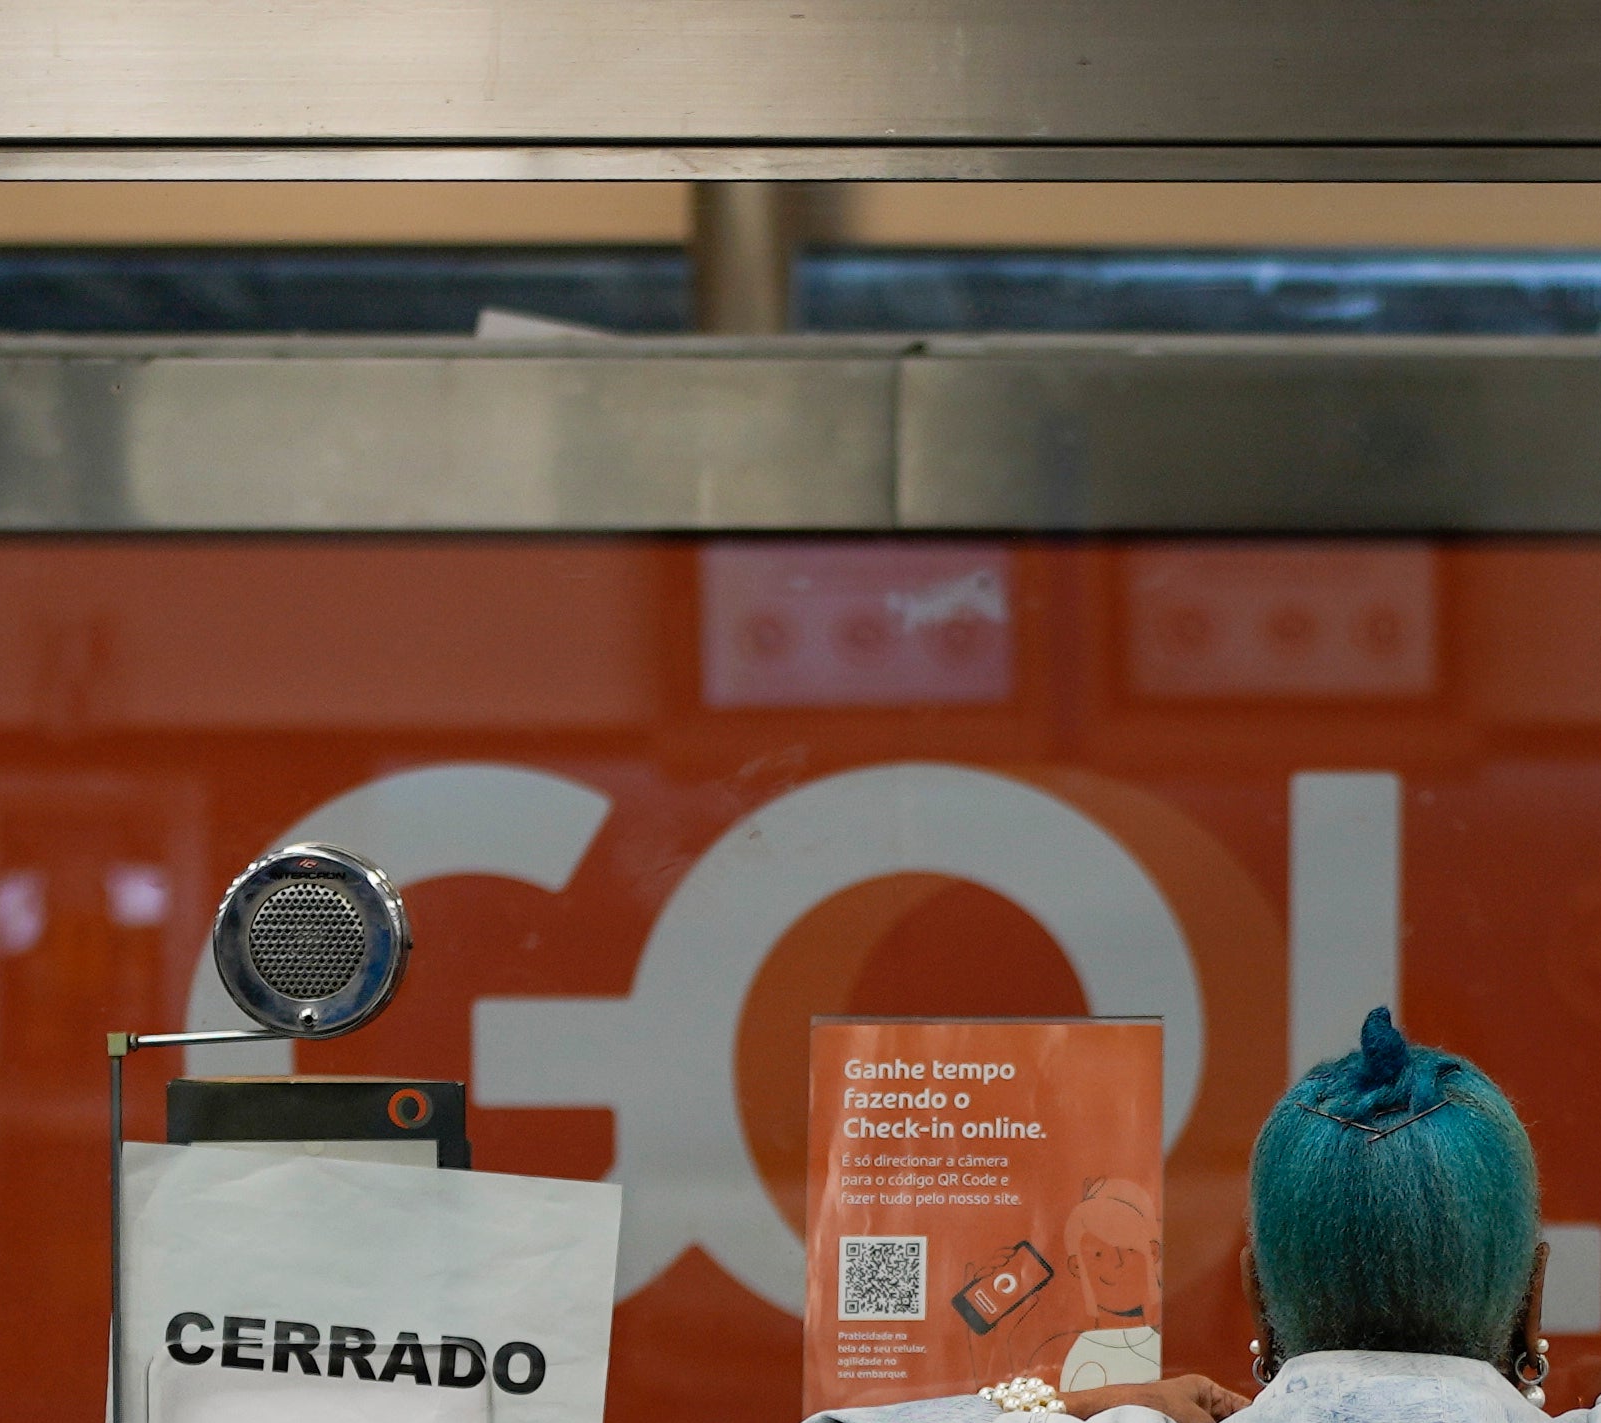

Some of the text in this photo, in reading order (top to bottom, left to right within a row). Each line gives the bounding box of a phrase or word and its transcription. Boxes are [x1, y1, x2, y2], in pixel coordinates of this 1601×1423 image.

[844, 1058, 1016, 1085] Ganhe tempo
[843, 1087, 970, 1110] fazendo o
[843, 1116, 1047, 1140] Check-in online.
[841, 1151, 1009, 1167] É só direcionar a câmera
[841, 1173, 1009, 1189] para o código QR Code e
[840, 1192, 1022, 1208] fazer tudo pelo nosso site.
[165, 1311, 547, 1396] CERRADO
